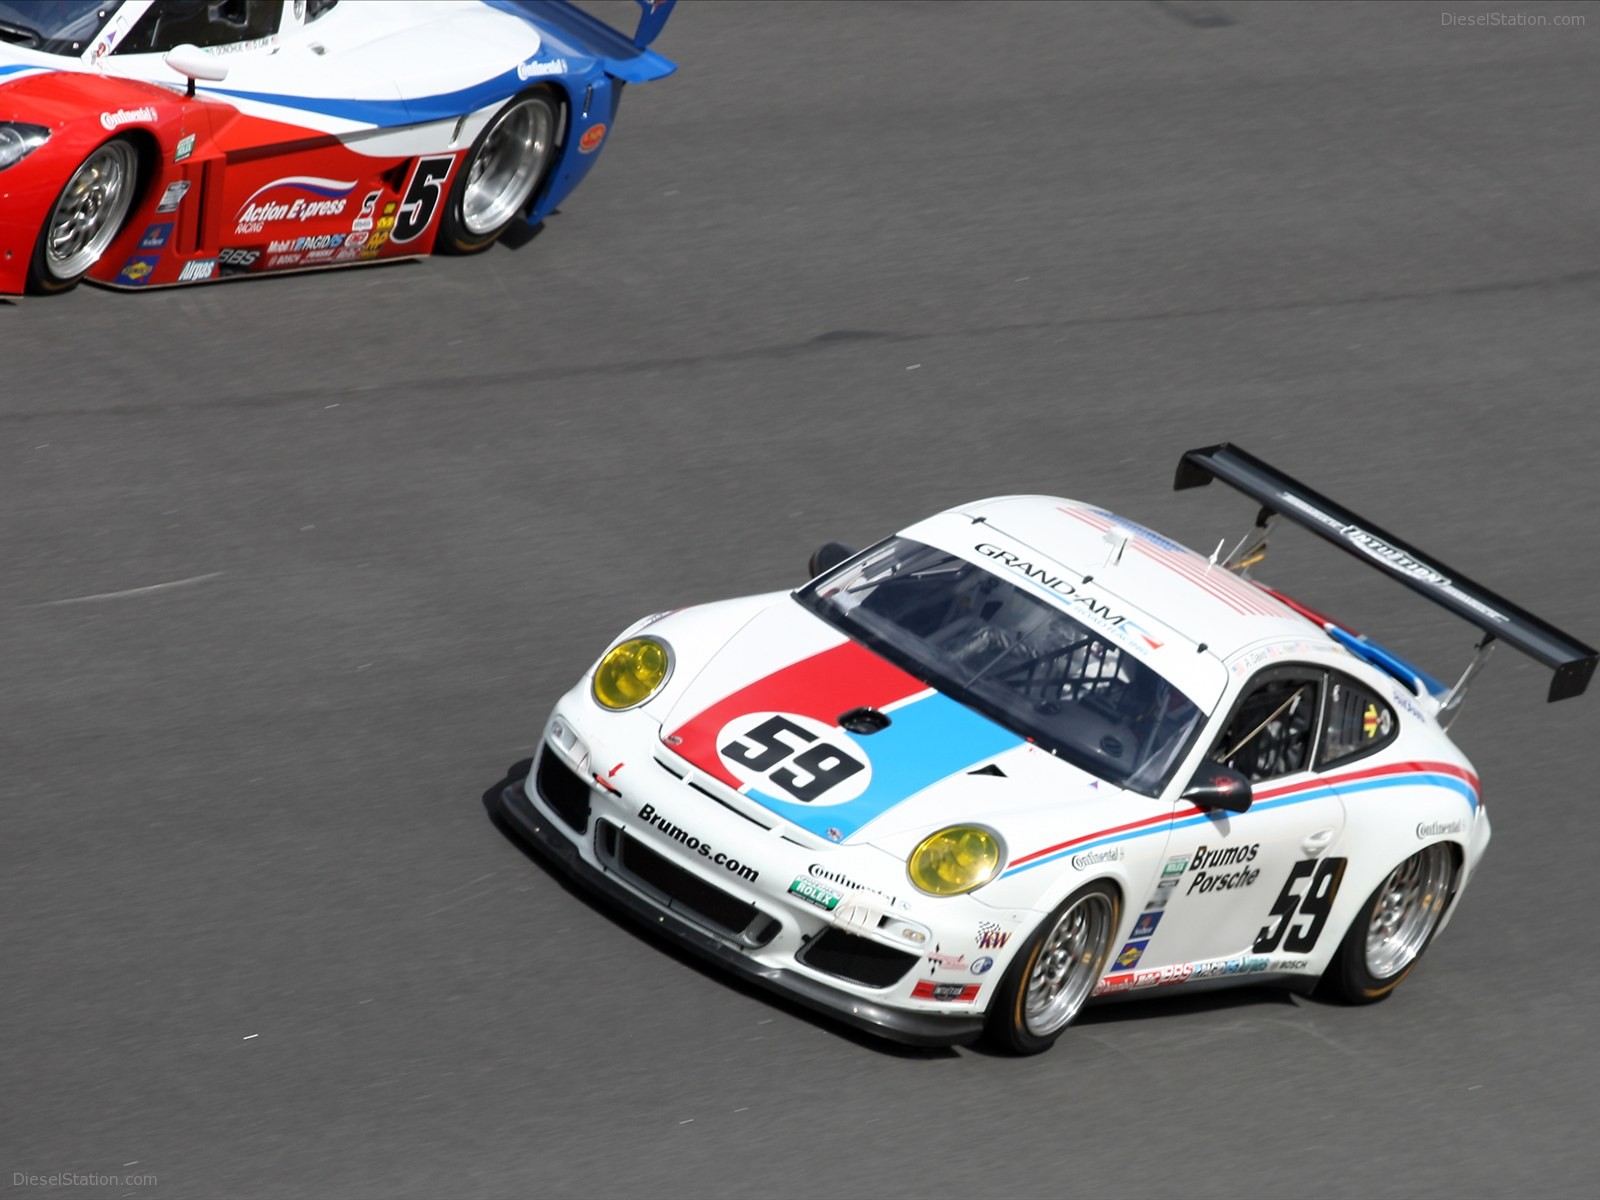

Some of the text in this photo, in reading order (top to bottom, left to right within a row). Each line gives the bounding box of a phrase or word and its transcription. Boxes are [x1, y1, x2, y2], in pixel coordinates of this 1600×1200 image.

[238, 200, 288, 223] Action
[390, 153, 455, 242] 5
[219, 248, 260, 266] BBS
[974, 543, 1126, 626] GRAND-AM
[720, 714, 866, 803] 59
[638, 803, 760, 883] Brumos.com
[1189, 843, 1261, 872] Brumos
[796, 881, 832, 905] ROLEX
[1186, 866, 1261, 896] Porsche
[1252, 857, 1348, 954] 59
[1278, 961, 1308, 974] BOSCH
